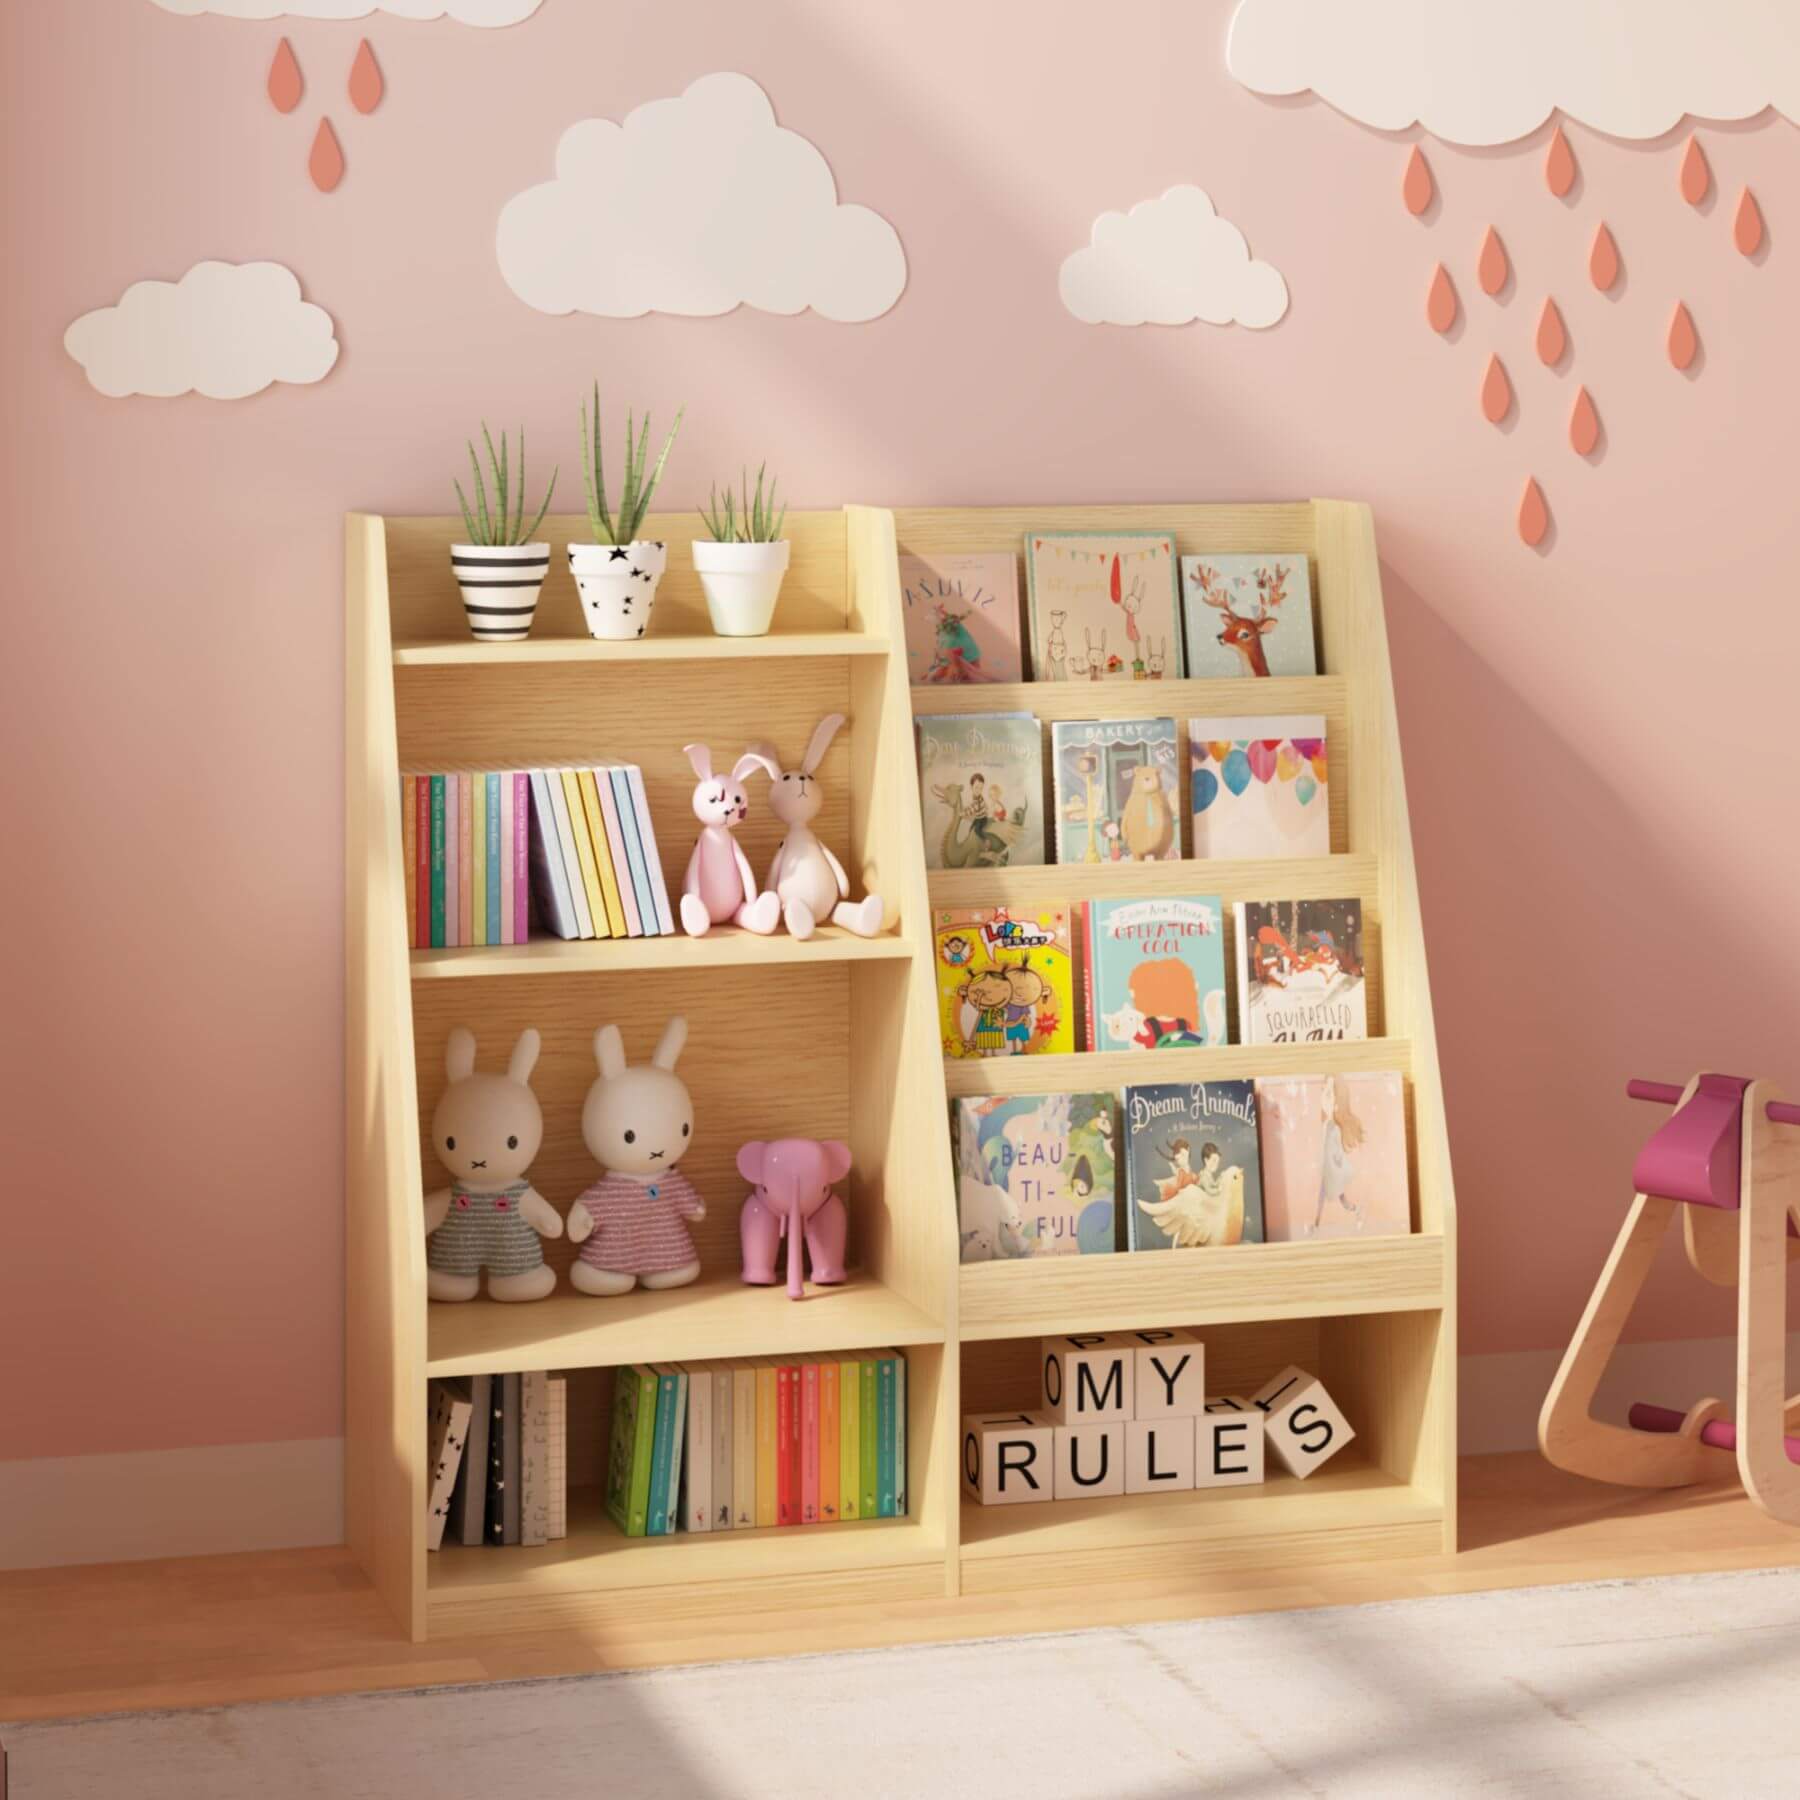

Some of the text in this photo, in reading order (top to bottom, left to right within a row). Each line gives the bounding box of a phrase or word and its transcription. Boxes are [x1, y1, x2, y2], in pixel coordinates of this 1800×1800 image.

[1085, 724, 1144, 739] BAKERY
[1113, 920, 1211, 941] OPERATION
[1142, 939, 1184, 954] COOL
[1129, 1082, 1256, 1135] Dream Animals
[1036, 1215, 1077, 1238] FUL
[1077, 1354, 1191, 1412] MY
[997, 1403, 1333, 1492] RULES
